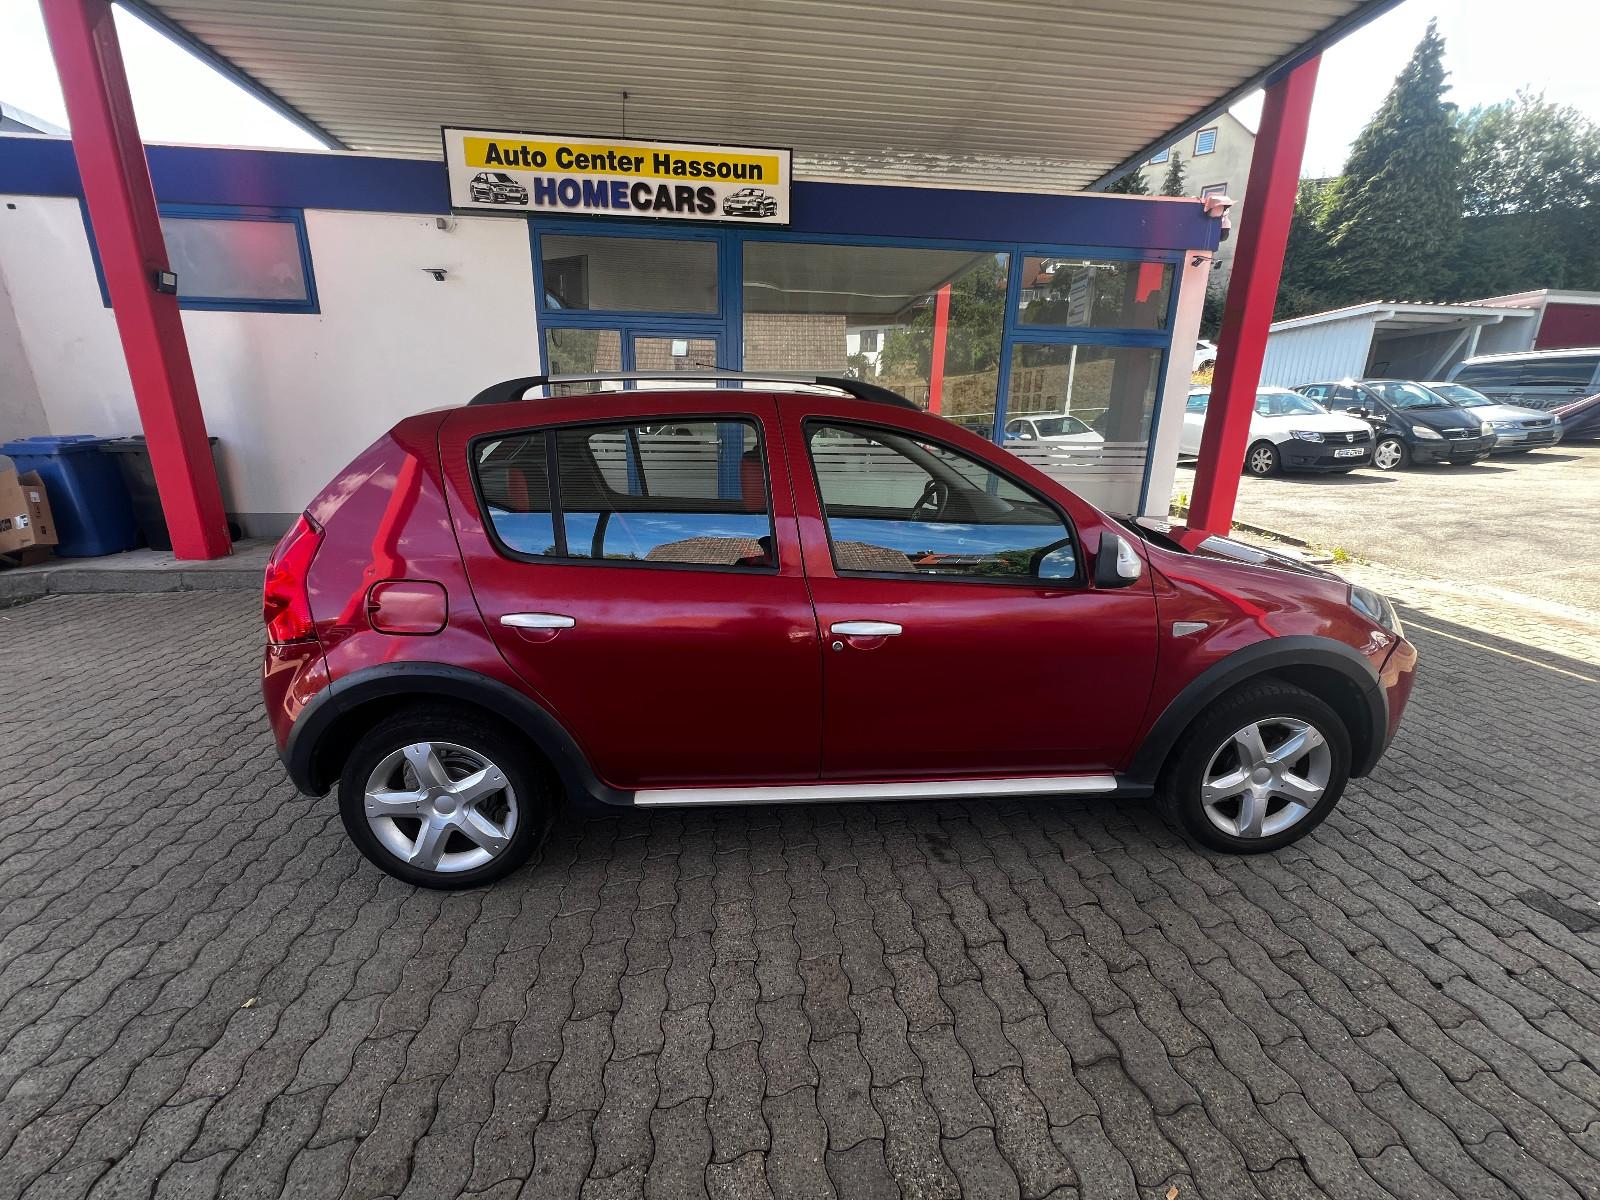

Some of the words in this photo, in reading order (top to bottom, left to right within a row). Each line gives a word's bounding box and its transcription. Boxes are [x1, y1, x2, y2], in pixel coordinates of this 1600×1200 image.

[485, 142, 547, 168] Auto
[555, 146, 645, 173] Center
[652, 153, 763, 180] Hassoun
[533, 176, 717, 214] HOMECARS
